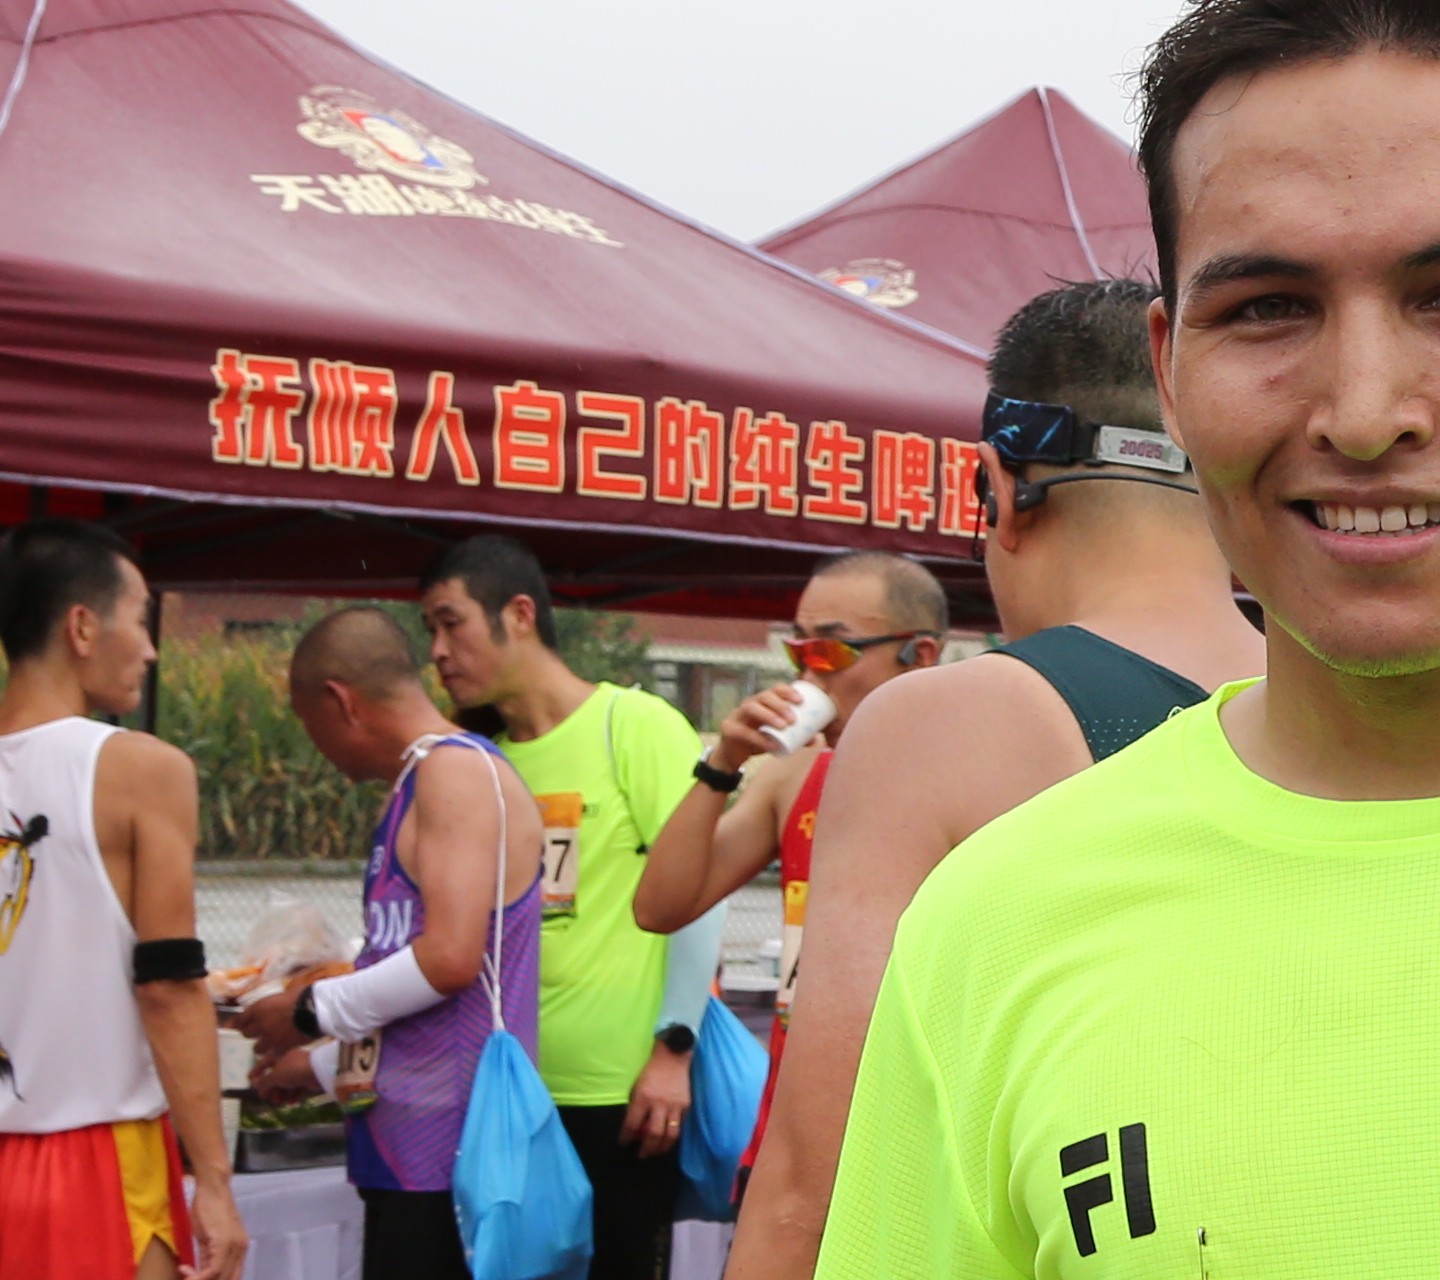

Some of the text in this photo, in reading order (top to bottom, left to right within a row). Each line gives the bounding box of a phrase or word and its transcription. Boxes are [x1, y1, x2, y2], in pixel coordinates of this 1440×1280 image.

[210, 347, 988, 540] 抚顺人自己的纯生啤酒
[540, 839, 571, 882] 7
